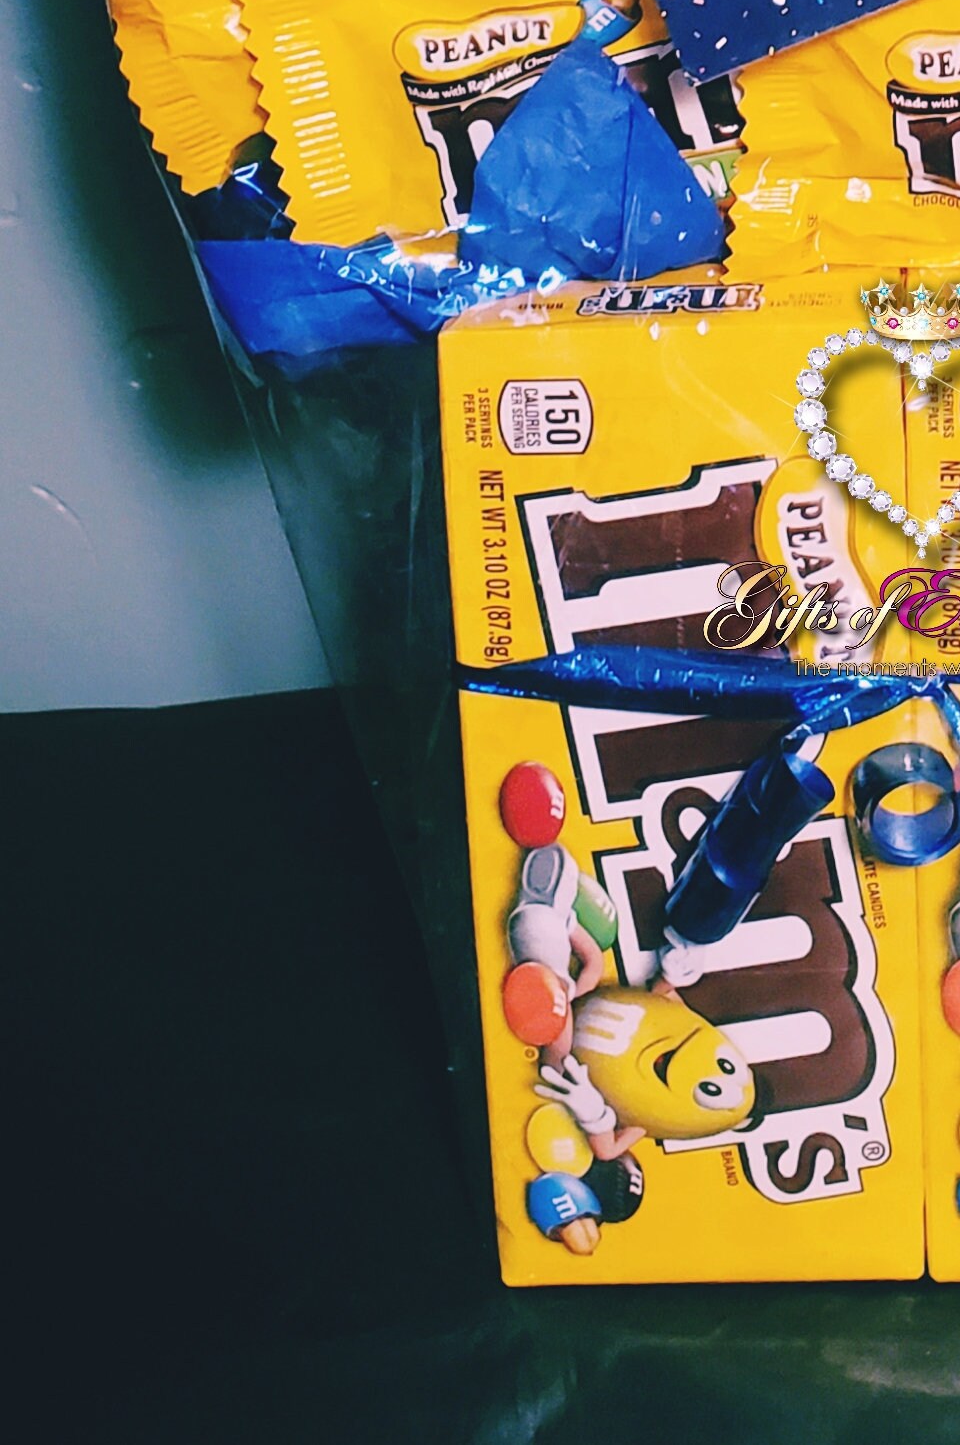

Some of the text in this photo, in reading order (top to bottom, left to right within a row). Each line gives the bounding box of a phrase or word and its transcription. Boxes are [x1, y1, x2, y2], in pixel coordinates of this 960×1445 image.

[424, 19, 552, 64] PEANUT
[588, 5, 617, 33] m
[407, 85, 441, 101] Made
[441, 83, 467, 100] with
[890, 92, 929, 109] Made
[930, 91, 960, 109] with
[463, 393, 477, 444] PER PACK
[478, 396, 493, 449] SERVINGS
[510, 386, 526, 449] PER SERVING
[523, 387, 541, 447] CALORIES
[544, 390, 582, 445] 150
[927, 404, 941, 433] PACK
[479, 470, 515, 665] NET WT 3.10 OZ (87.9g)
[866, 881, 888, 931] CANDIES
[573, 1000, 646, 1055] m
[628, 1165, 645, 1197] m
[721, 1148, 740, 1188] BRAND
[551, 1191, 578, 1219] m
